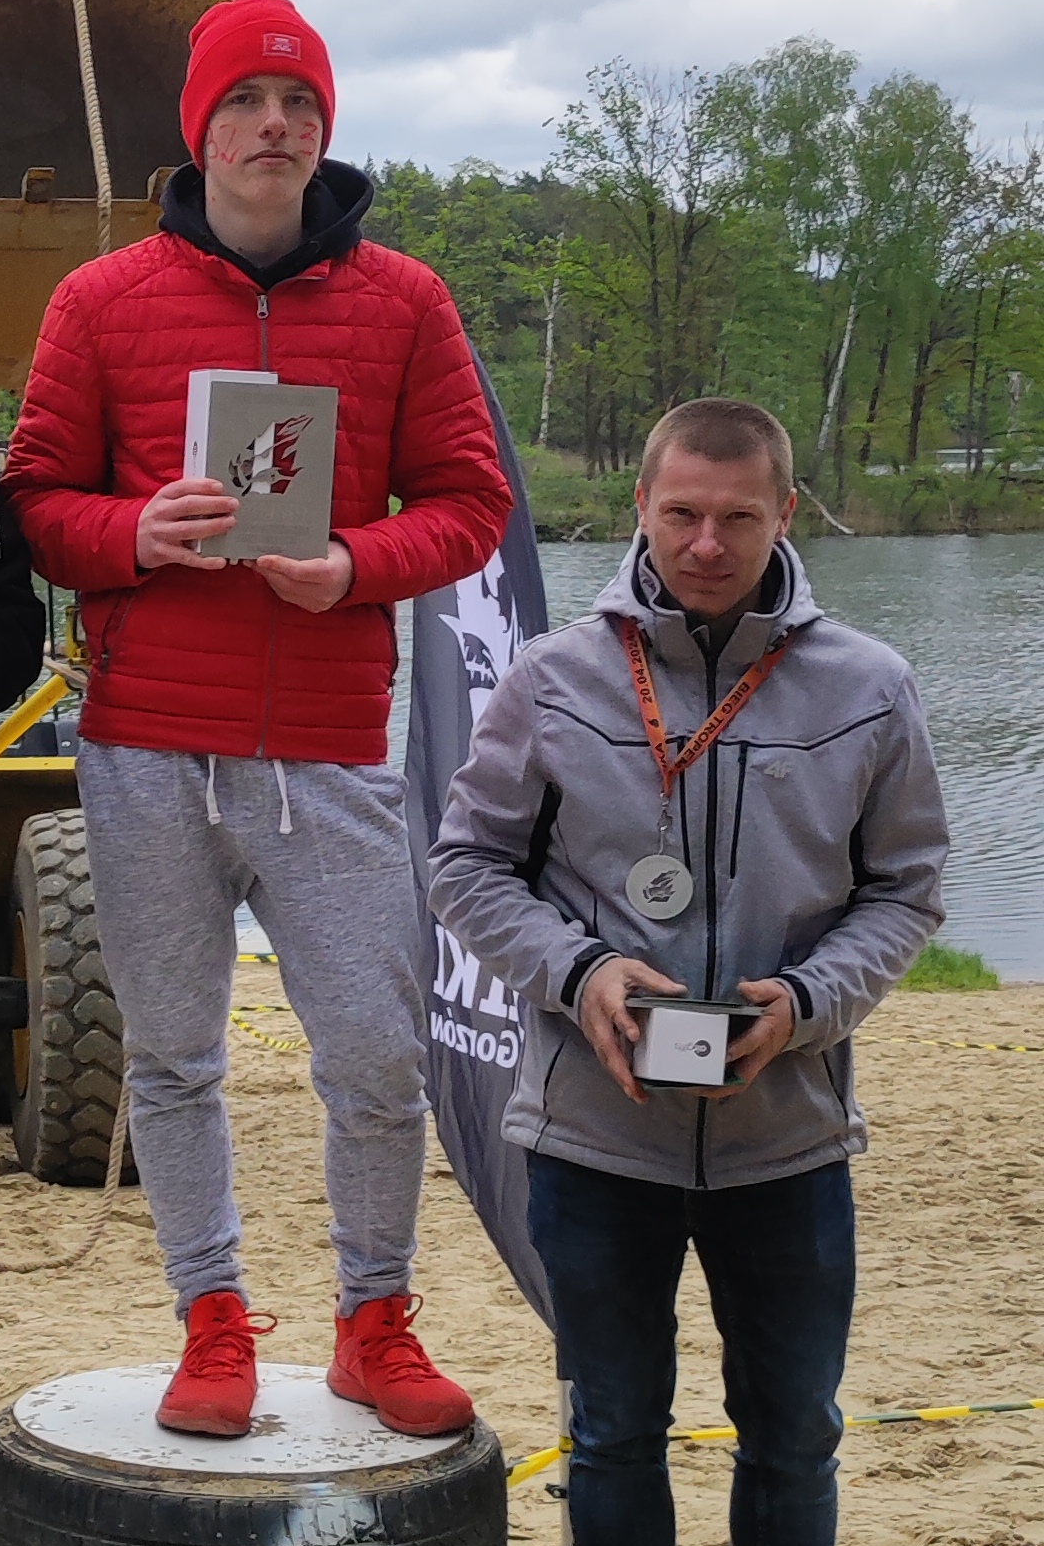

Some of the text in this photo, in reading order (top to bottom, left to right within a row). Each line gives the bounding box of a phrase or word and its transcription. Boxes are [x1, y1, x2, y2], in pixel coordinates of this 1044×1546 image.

[673, 681, 751, 769] BIEG TROPEM
[763, 760, 793, 779] 4F
